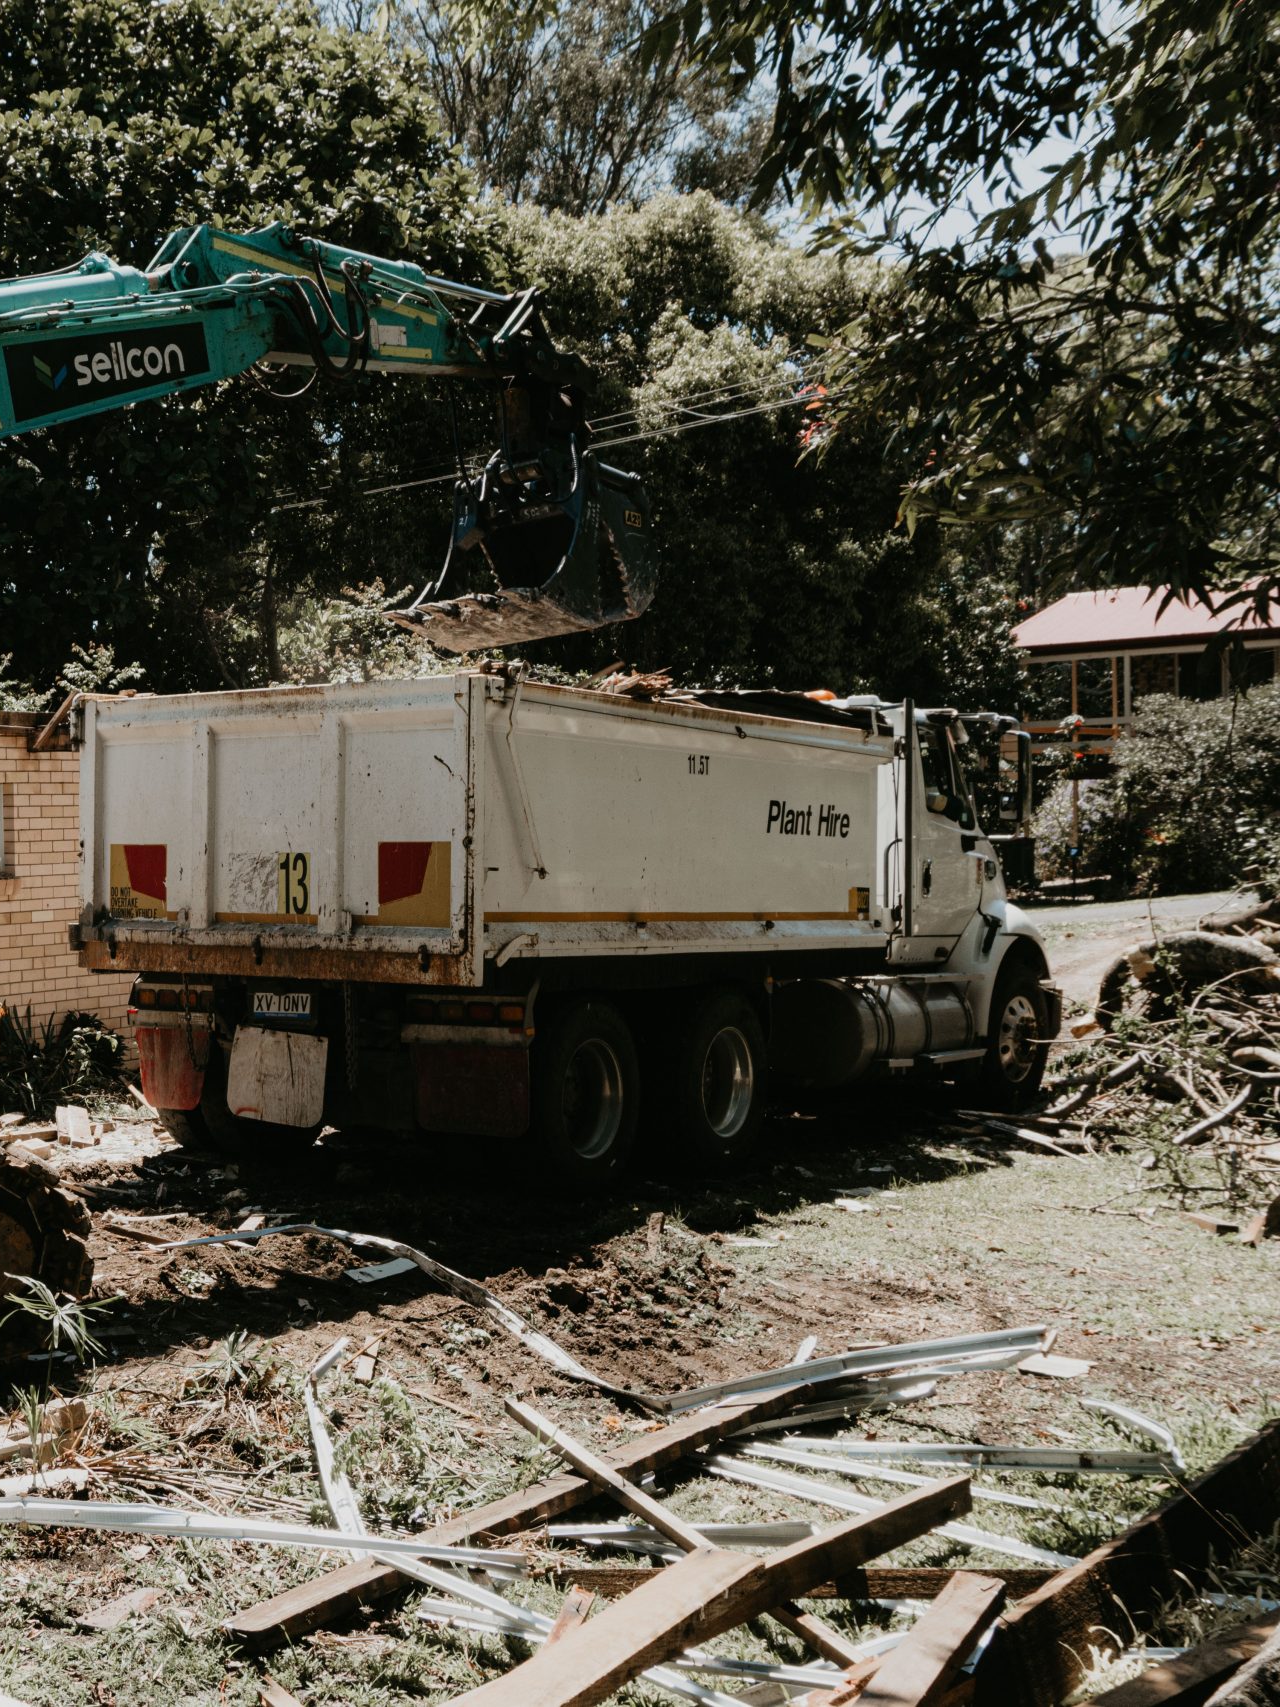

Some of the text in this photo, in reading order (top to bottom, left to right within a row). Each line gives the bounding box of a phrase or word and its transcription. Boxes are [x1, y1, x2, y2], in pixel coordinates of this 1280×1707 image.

[74, 341, 185, 386] sellcon
[766, 800, 850, 838] Plant Hire
[111, 887, 131, 897] DO NOT
[111, 897, 138, 908] OVERTAKE
[280, 853, 308, 914] 13
